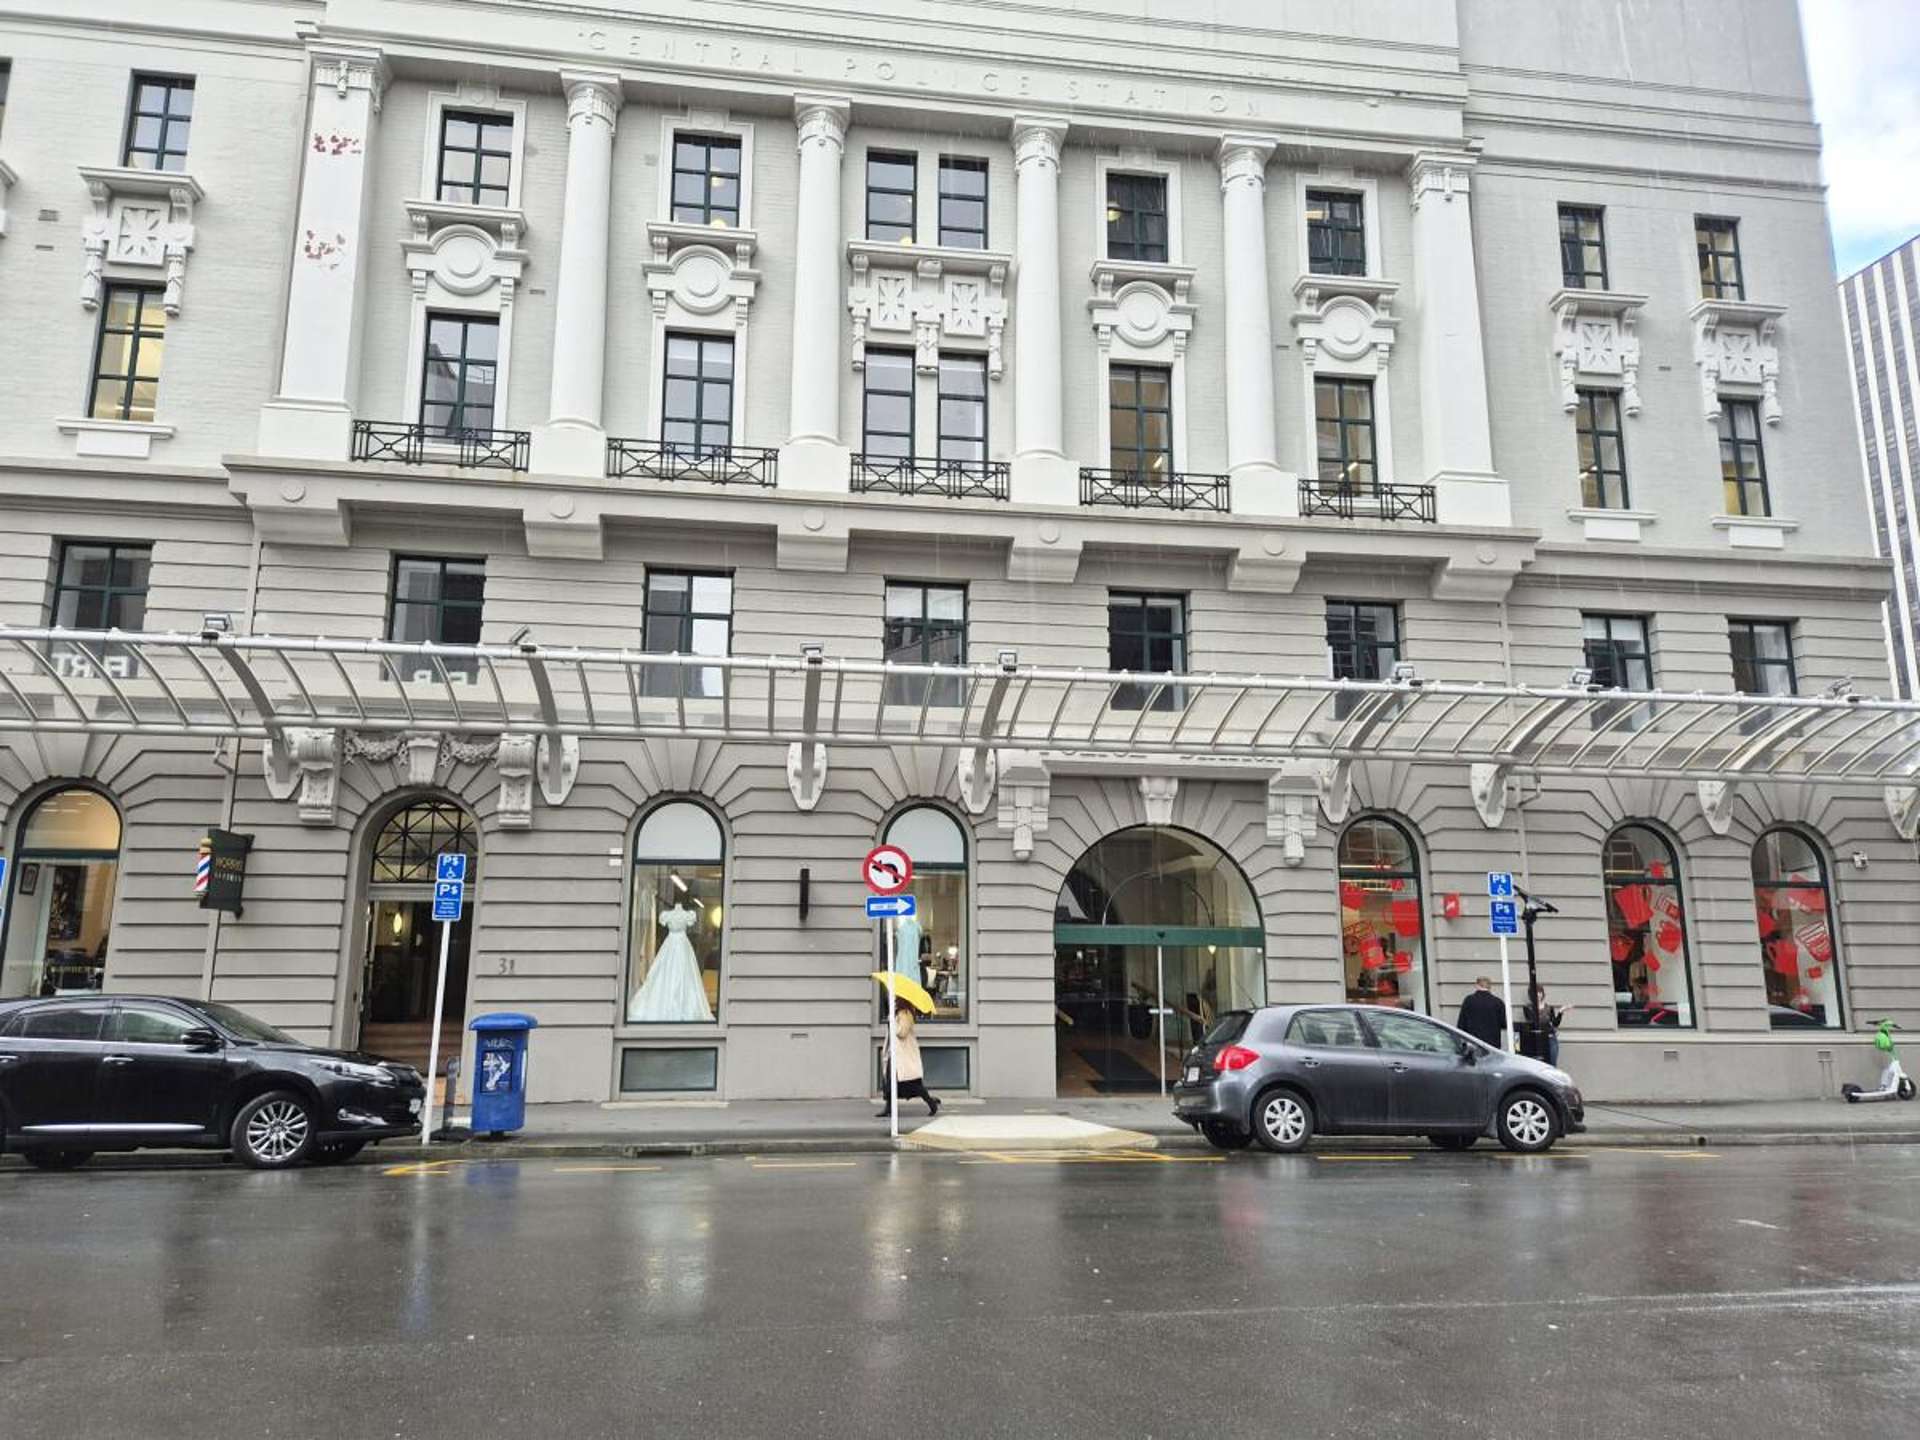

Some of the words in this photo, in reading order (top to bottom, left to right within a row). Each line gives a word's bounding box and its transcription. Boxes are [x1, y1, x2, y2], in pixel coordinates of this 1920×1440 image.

[588, 30, 805, 73] CENTRAL
[843, 57, 1030, 96] POLICE
[1066, 78, 1263, 117] STATION
[498, 957, 515, 975] 31
